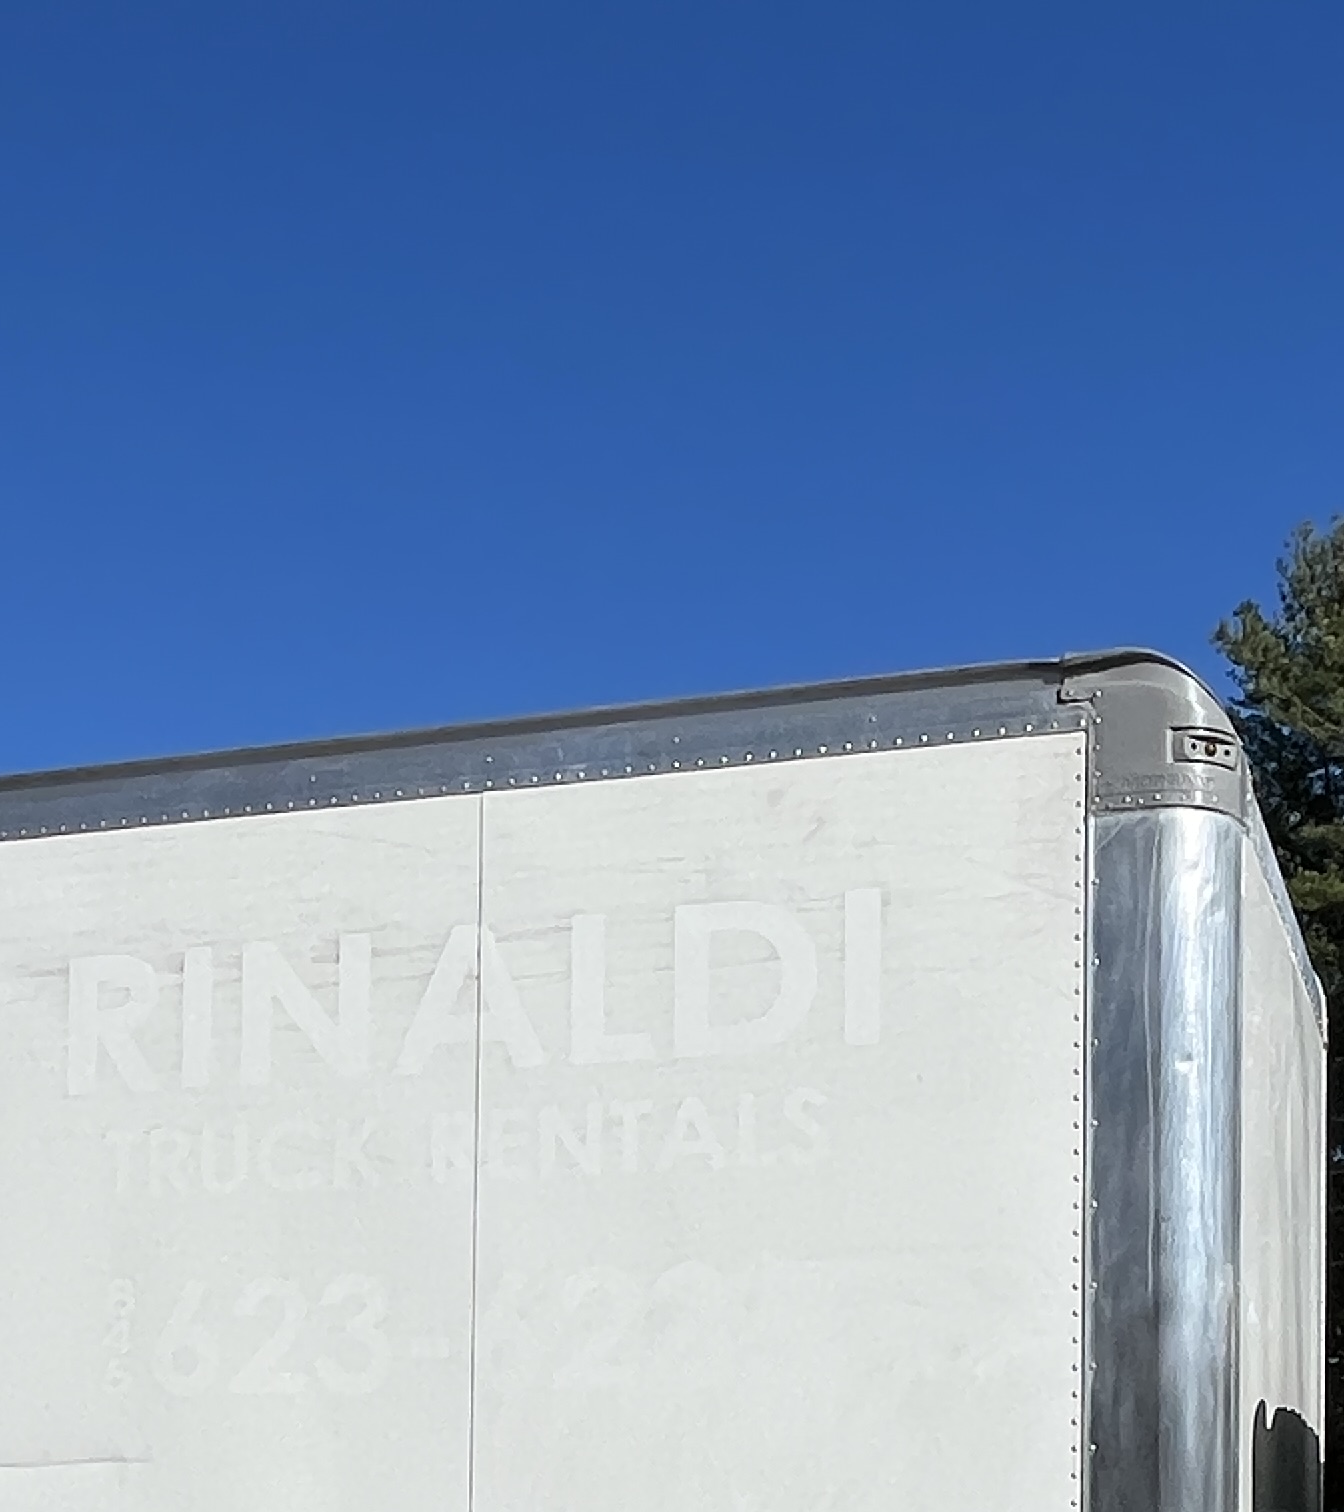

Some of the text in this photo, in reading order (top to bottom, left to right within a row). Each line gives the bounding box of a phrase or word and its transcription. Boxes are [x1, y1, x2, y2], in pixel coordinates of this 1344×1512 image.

[66, 888, 882, 1097] RINALDI
[104, 1086, 833, 1195] TRUCK RENTALS
